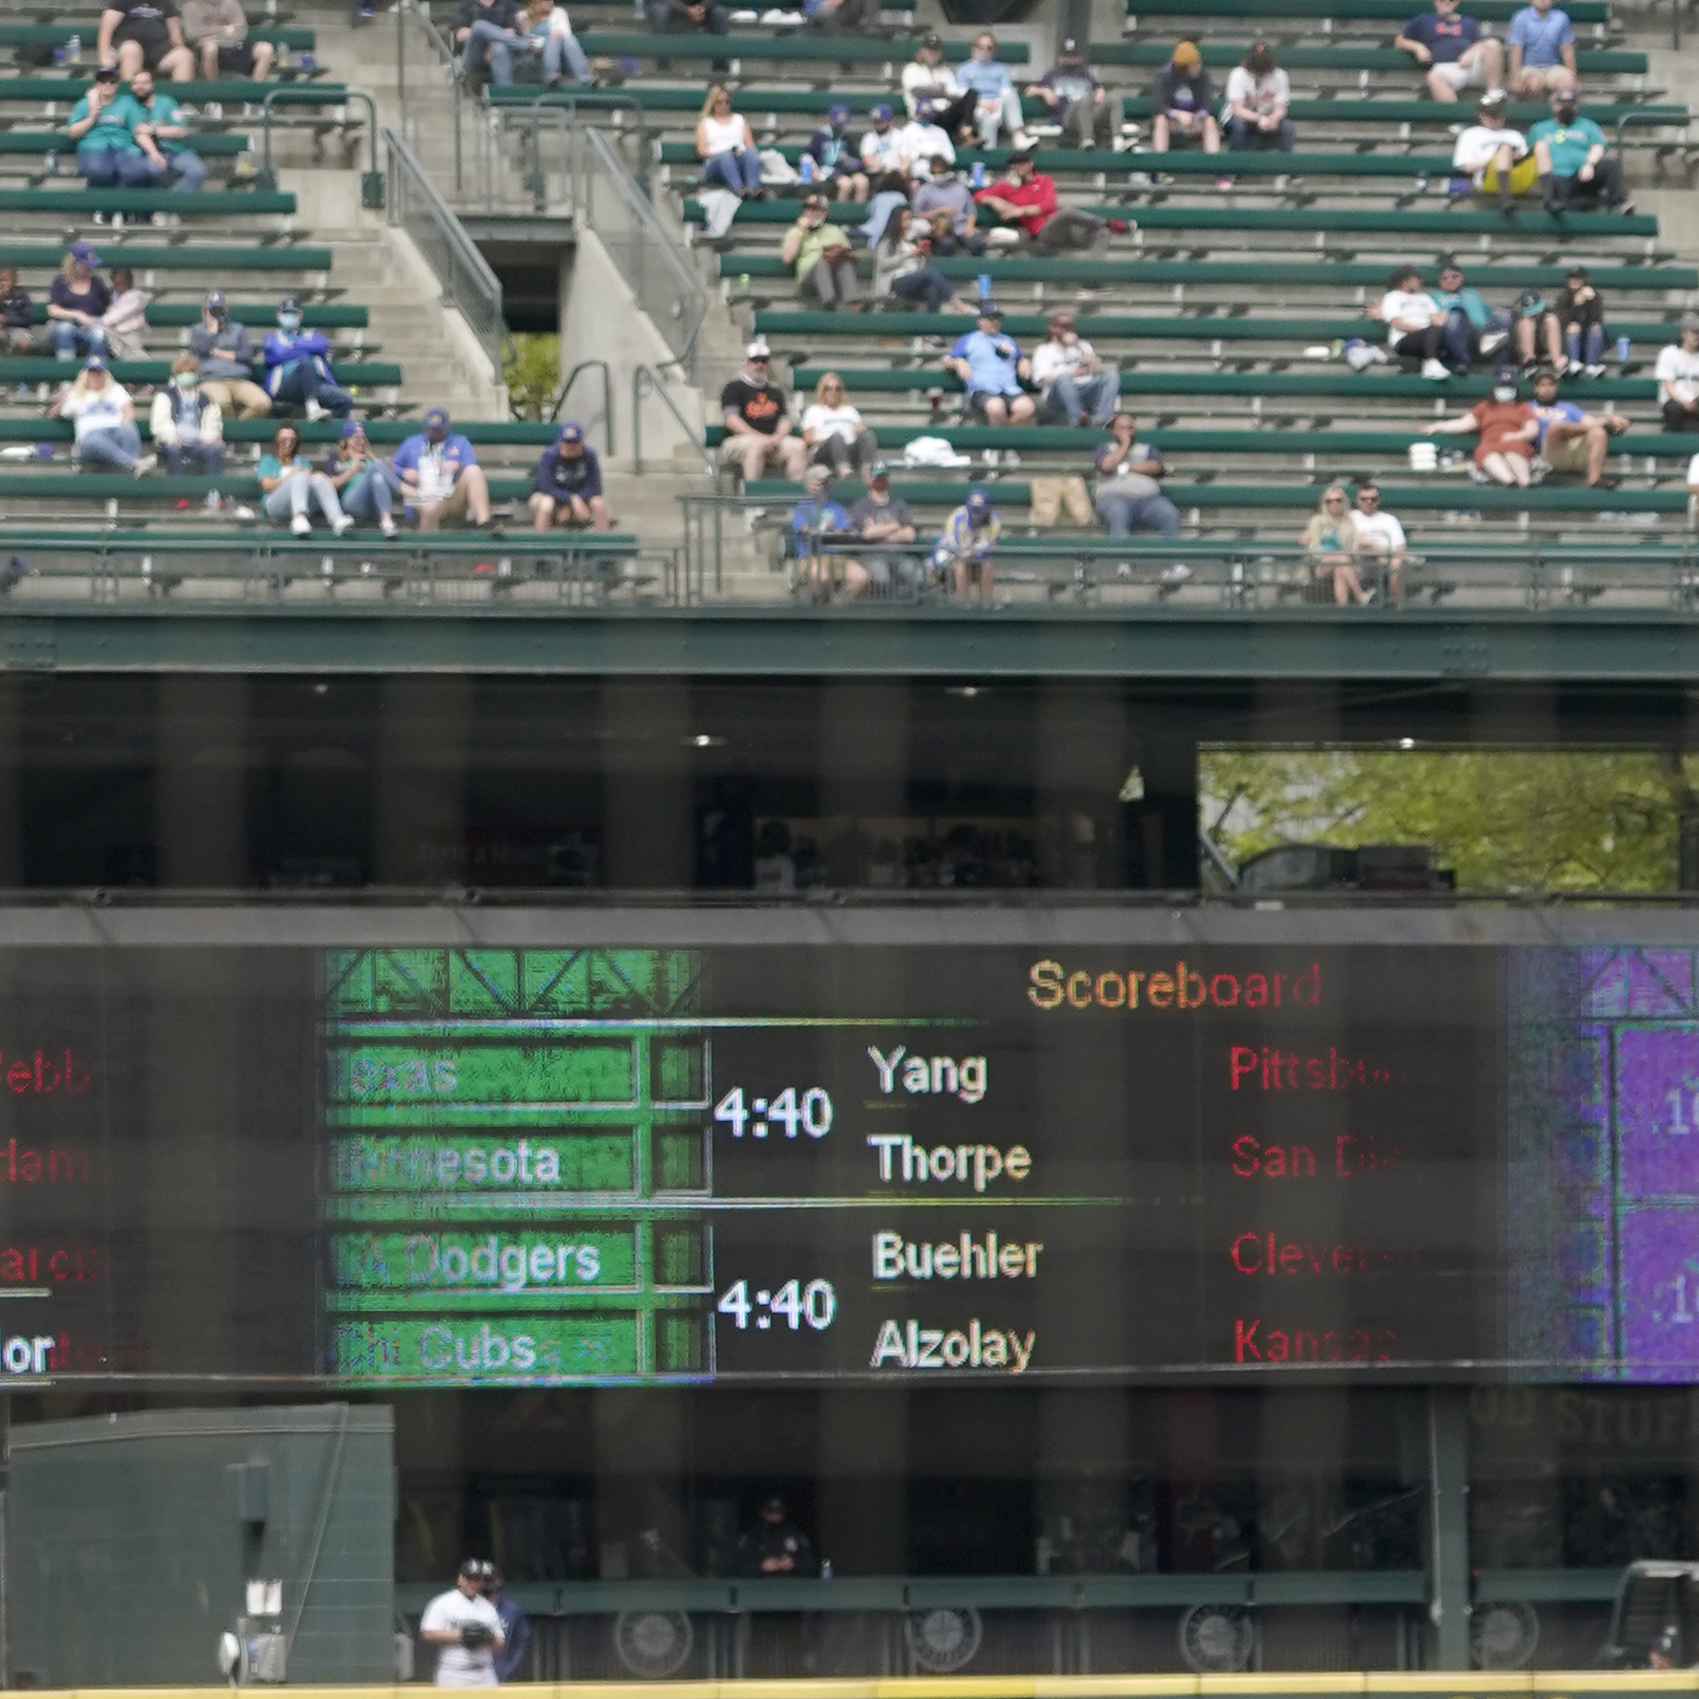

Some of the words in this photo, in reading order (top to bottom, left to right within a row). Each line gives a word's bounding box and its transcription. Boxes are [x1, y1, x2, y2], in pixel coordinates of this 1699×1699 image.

[1027, 959, 1321, 1009] Scoreboard
[867, 1044, 988, 1104] Yang
[714, 1086, 834, 1138] 4:40
[867, 1134, 1032, 1192] Thorpe
[1232, 1135, 1316, 1178] San
[405, 1235, 601, 1293] Dodgers
[872, 1229, 1043, 1279] Buehler
[718, 1277, 838, 1330] 4:40
[418, 1322, 537, 1370] Cubs
[870, 1317, 1036, 1375] Alzolay
